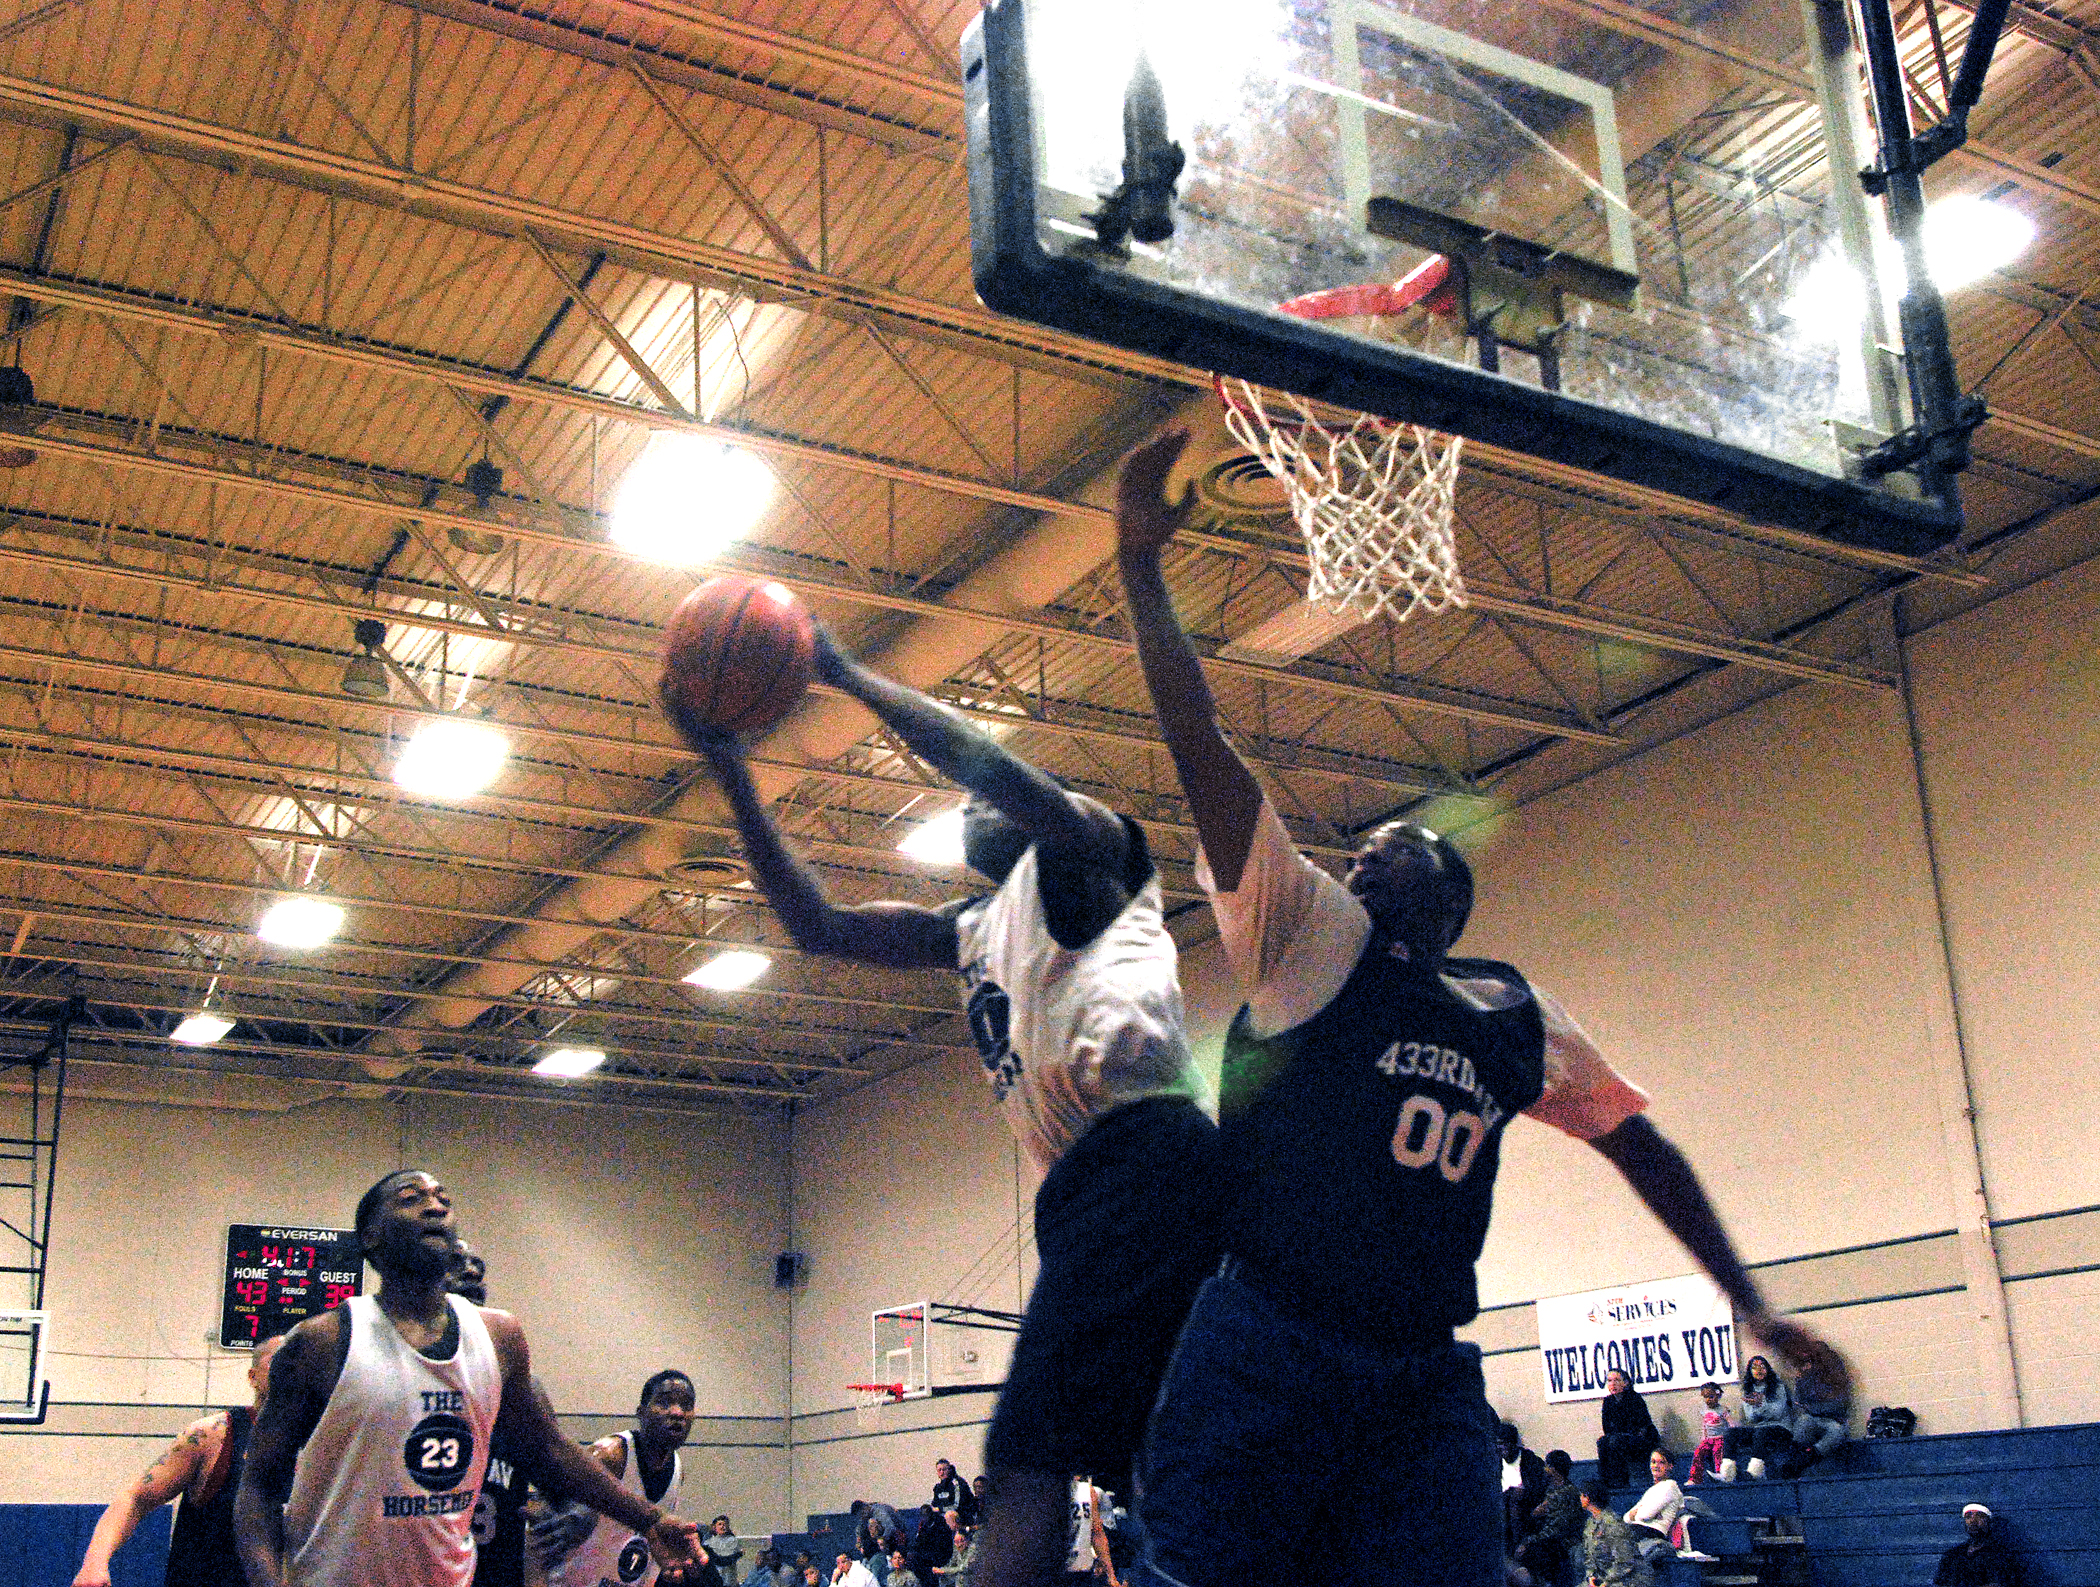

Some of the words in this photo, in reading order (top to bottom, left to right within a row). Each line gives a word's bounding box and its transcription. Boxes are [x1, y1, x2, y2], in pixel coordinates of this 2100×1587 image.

[1375, 1041, 1476, 1092] 433RD
[1391, 1094, 1484, 1183] 00
[271, 1229, 338, 1241] EVERSAN
[233, 1267, 269, 1280] HOME
[282, 1269, 308, 1277] BONUS
[319, 1271, 357, 1284] GUEST
[236, 1281, 269, 1305] 43
[281, 1287, 307, 1296] PERIOD
[282, 1307, 307, 1315] PLAYER
[1608, 1298, 1677, 1322] SERVICES
[245, 1314, 260, 1338] 7
[230, 1339, 254, 1347] POINTS
[1545, 1333, 1674, 1394] WELCOMES
[1682, 1324, 1733, 1378] YOU
[421, 1390, 464, 1412] THE
[421, 1438, 460, 1469] 23
